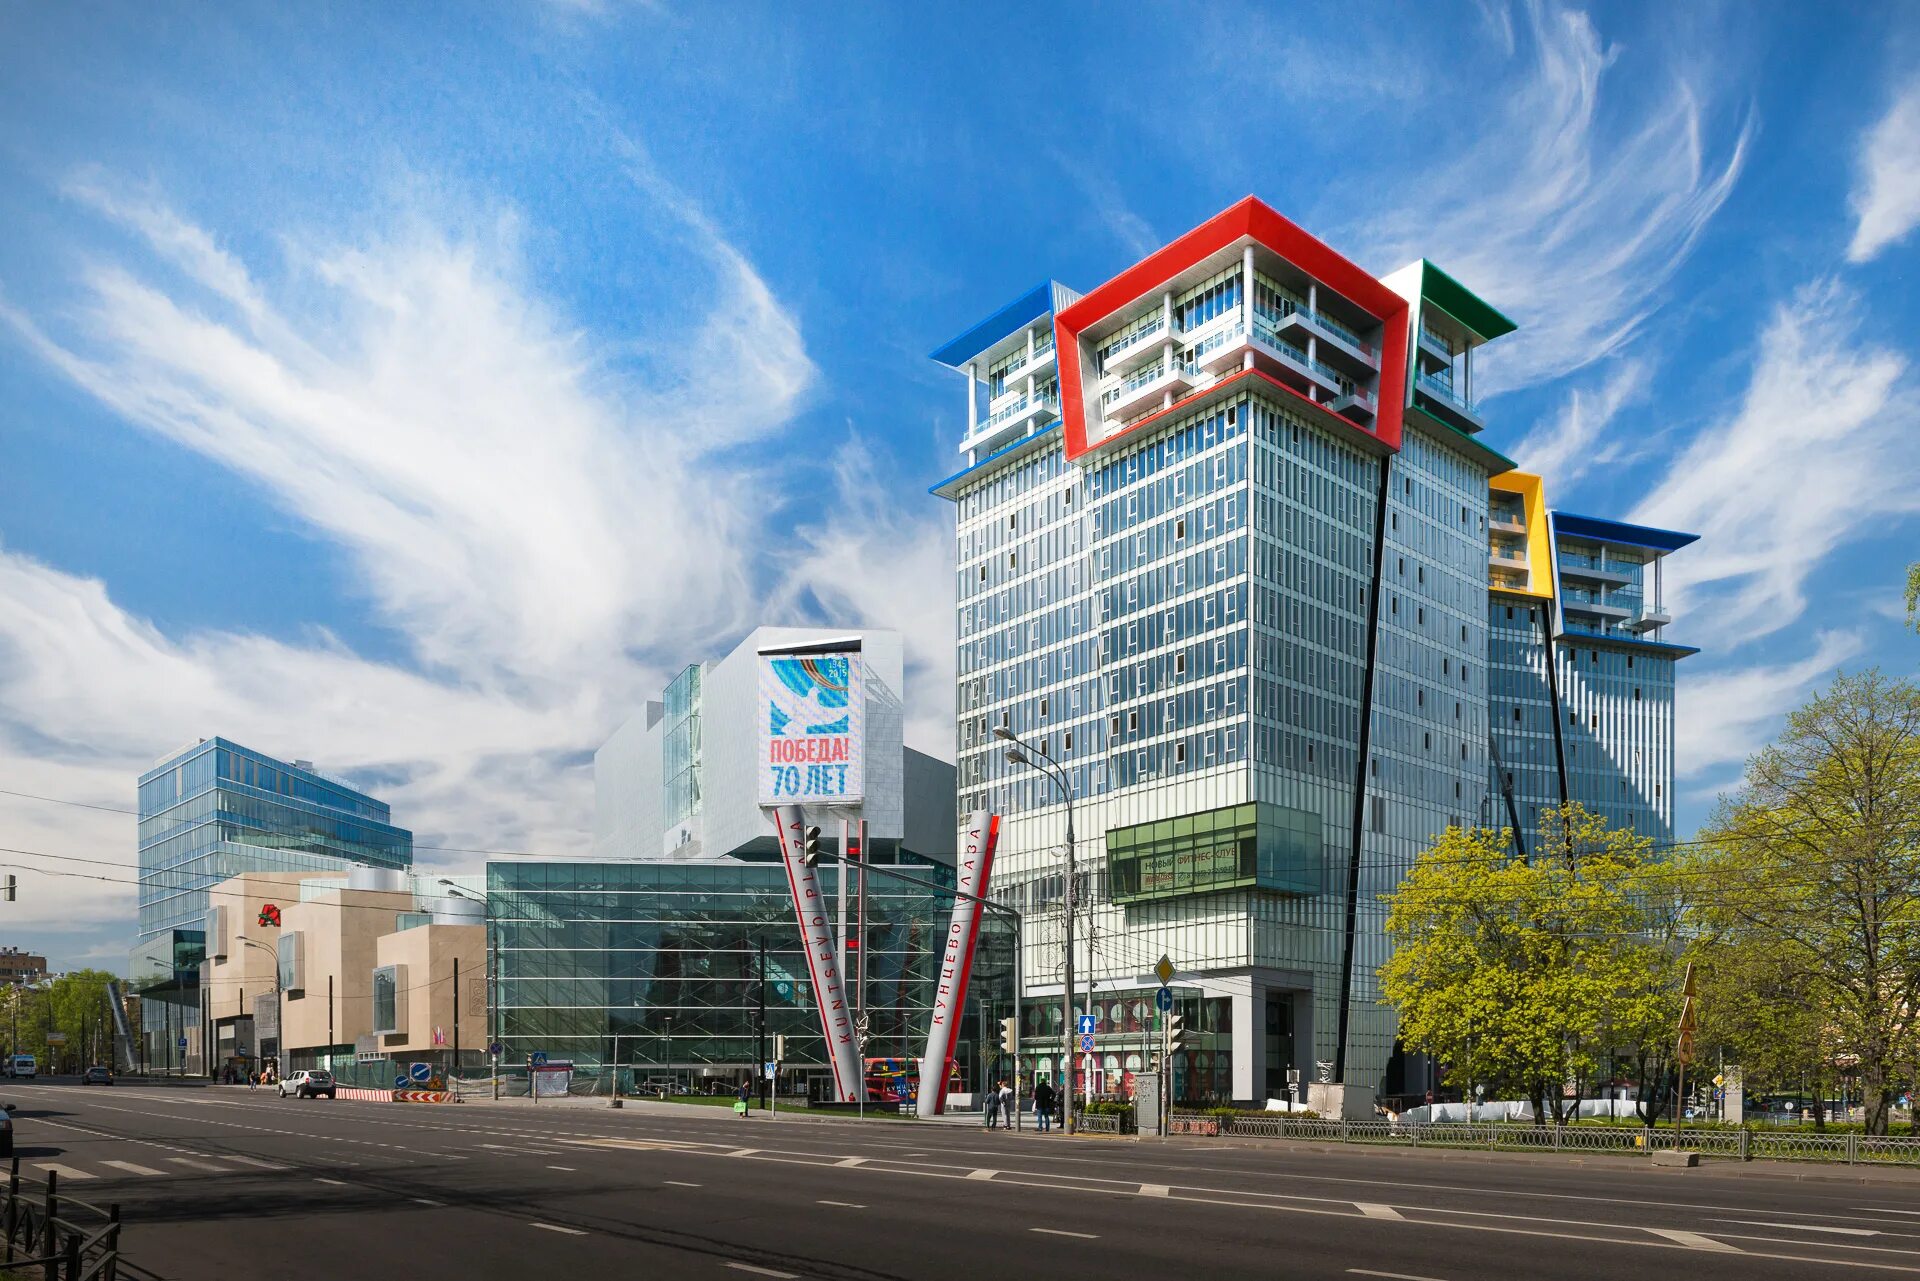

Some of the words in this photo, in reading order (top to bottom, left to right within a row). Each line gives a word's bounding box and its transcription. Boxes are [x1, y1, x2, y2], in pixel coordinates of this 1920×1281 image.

[770, 738, 849, 763] ПОБЕДА!
[771, 766, 800, 796] 70
[804, 765, 849, 795] ЛЕТ
[812, 916, 852, 1044] KUNTSEVO
[933, 923, 961, 1025] КУНЦЕВО
